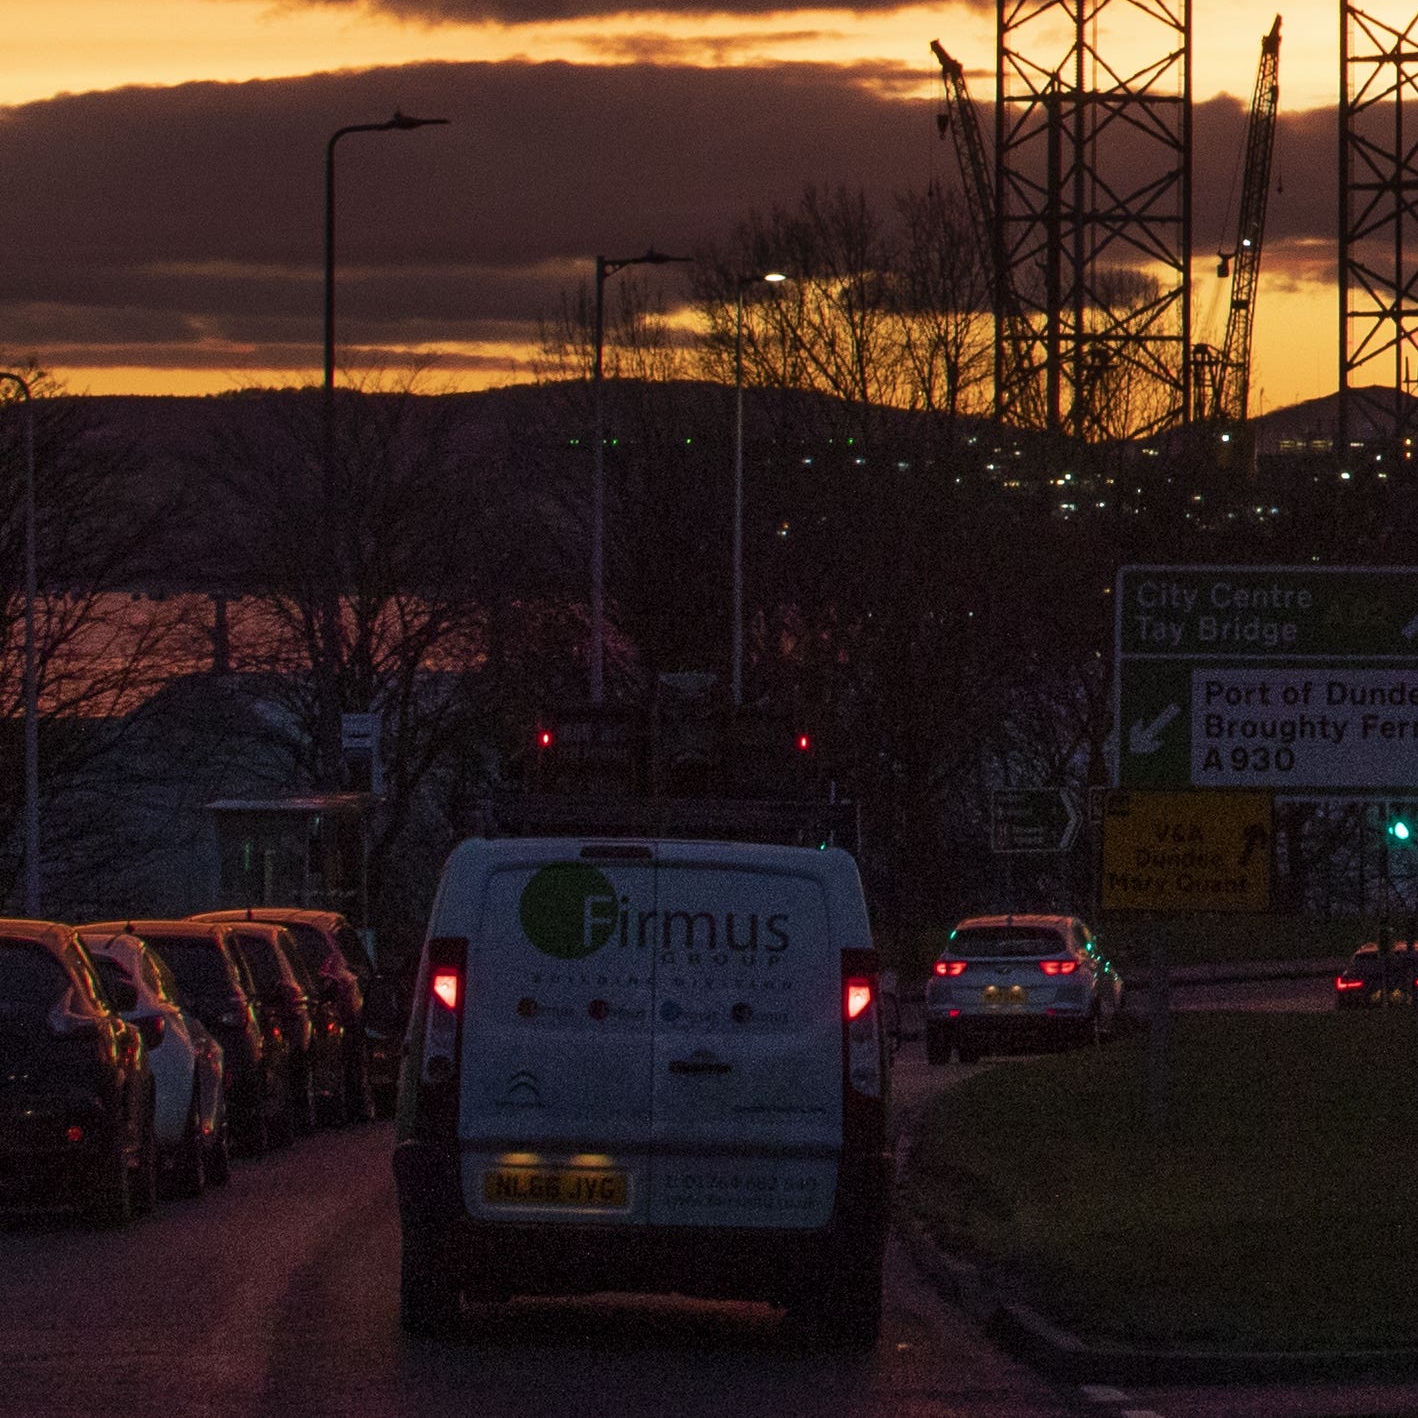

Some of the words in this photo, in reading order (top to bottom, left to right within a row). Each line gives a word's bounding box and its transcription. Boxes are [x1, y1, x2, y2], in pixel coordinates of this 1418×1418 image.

[1136, 582, 1199, 612] City
[1210, 582, 1314, 610] Centre
[1135, 616, 1186, 646] Tay
[1198, 616, 1299, 647] Bridge
[1205, 681, 1271, 706] Port
[1282, 681, 1313, 706] of
[1204, 714, 1349, 743] Broughty
[1134, 846, 1224, 869] Dundee
[582, 893, 791, 953] Firmus
[659, 952, 782, 968] GROUP
